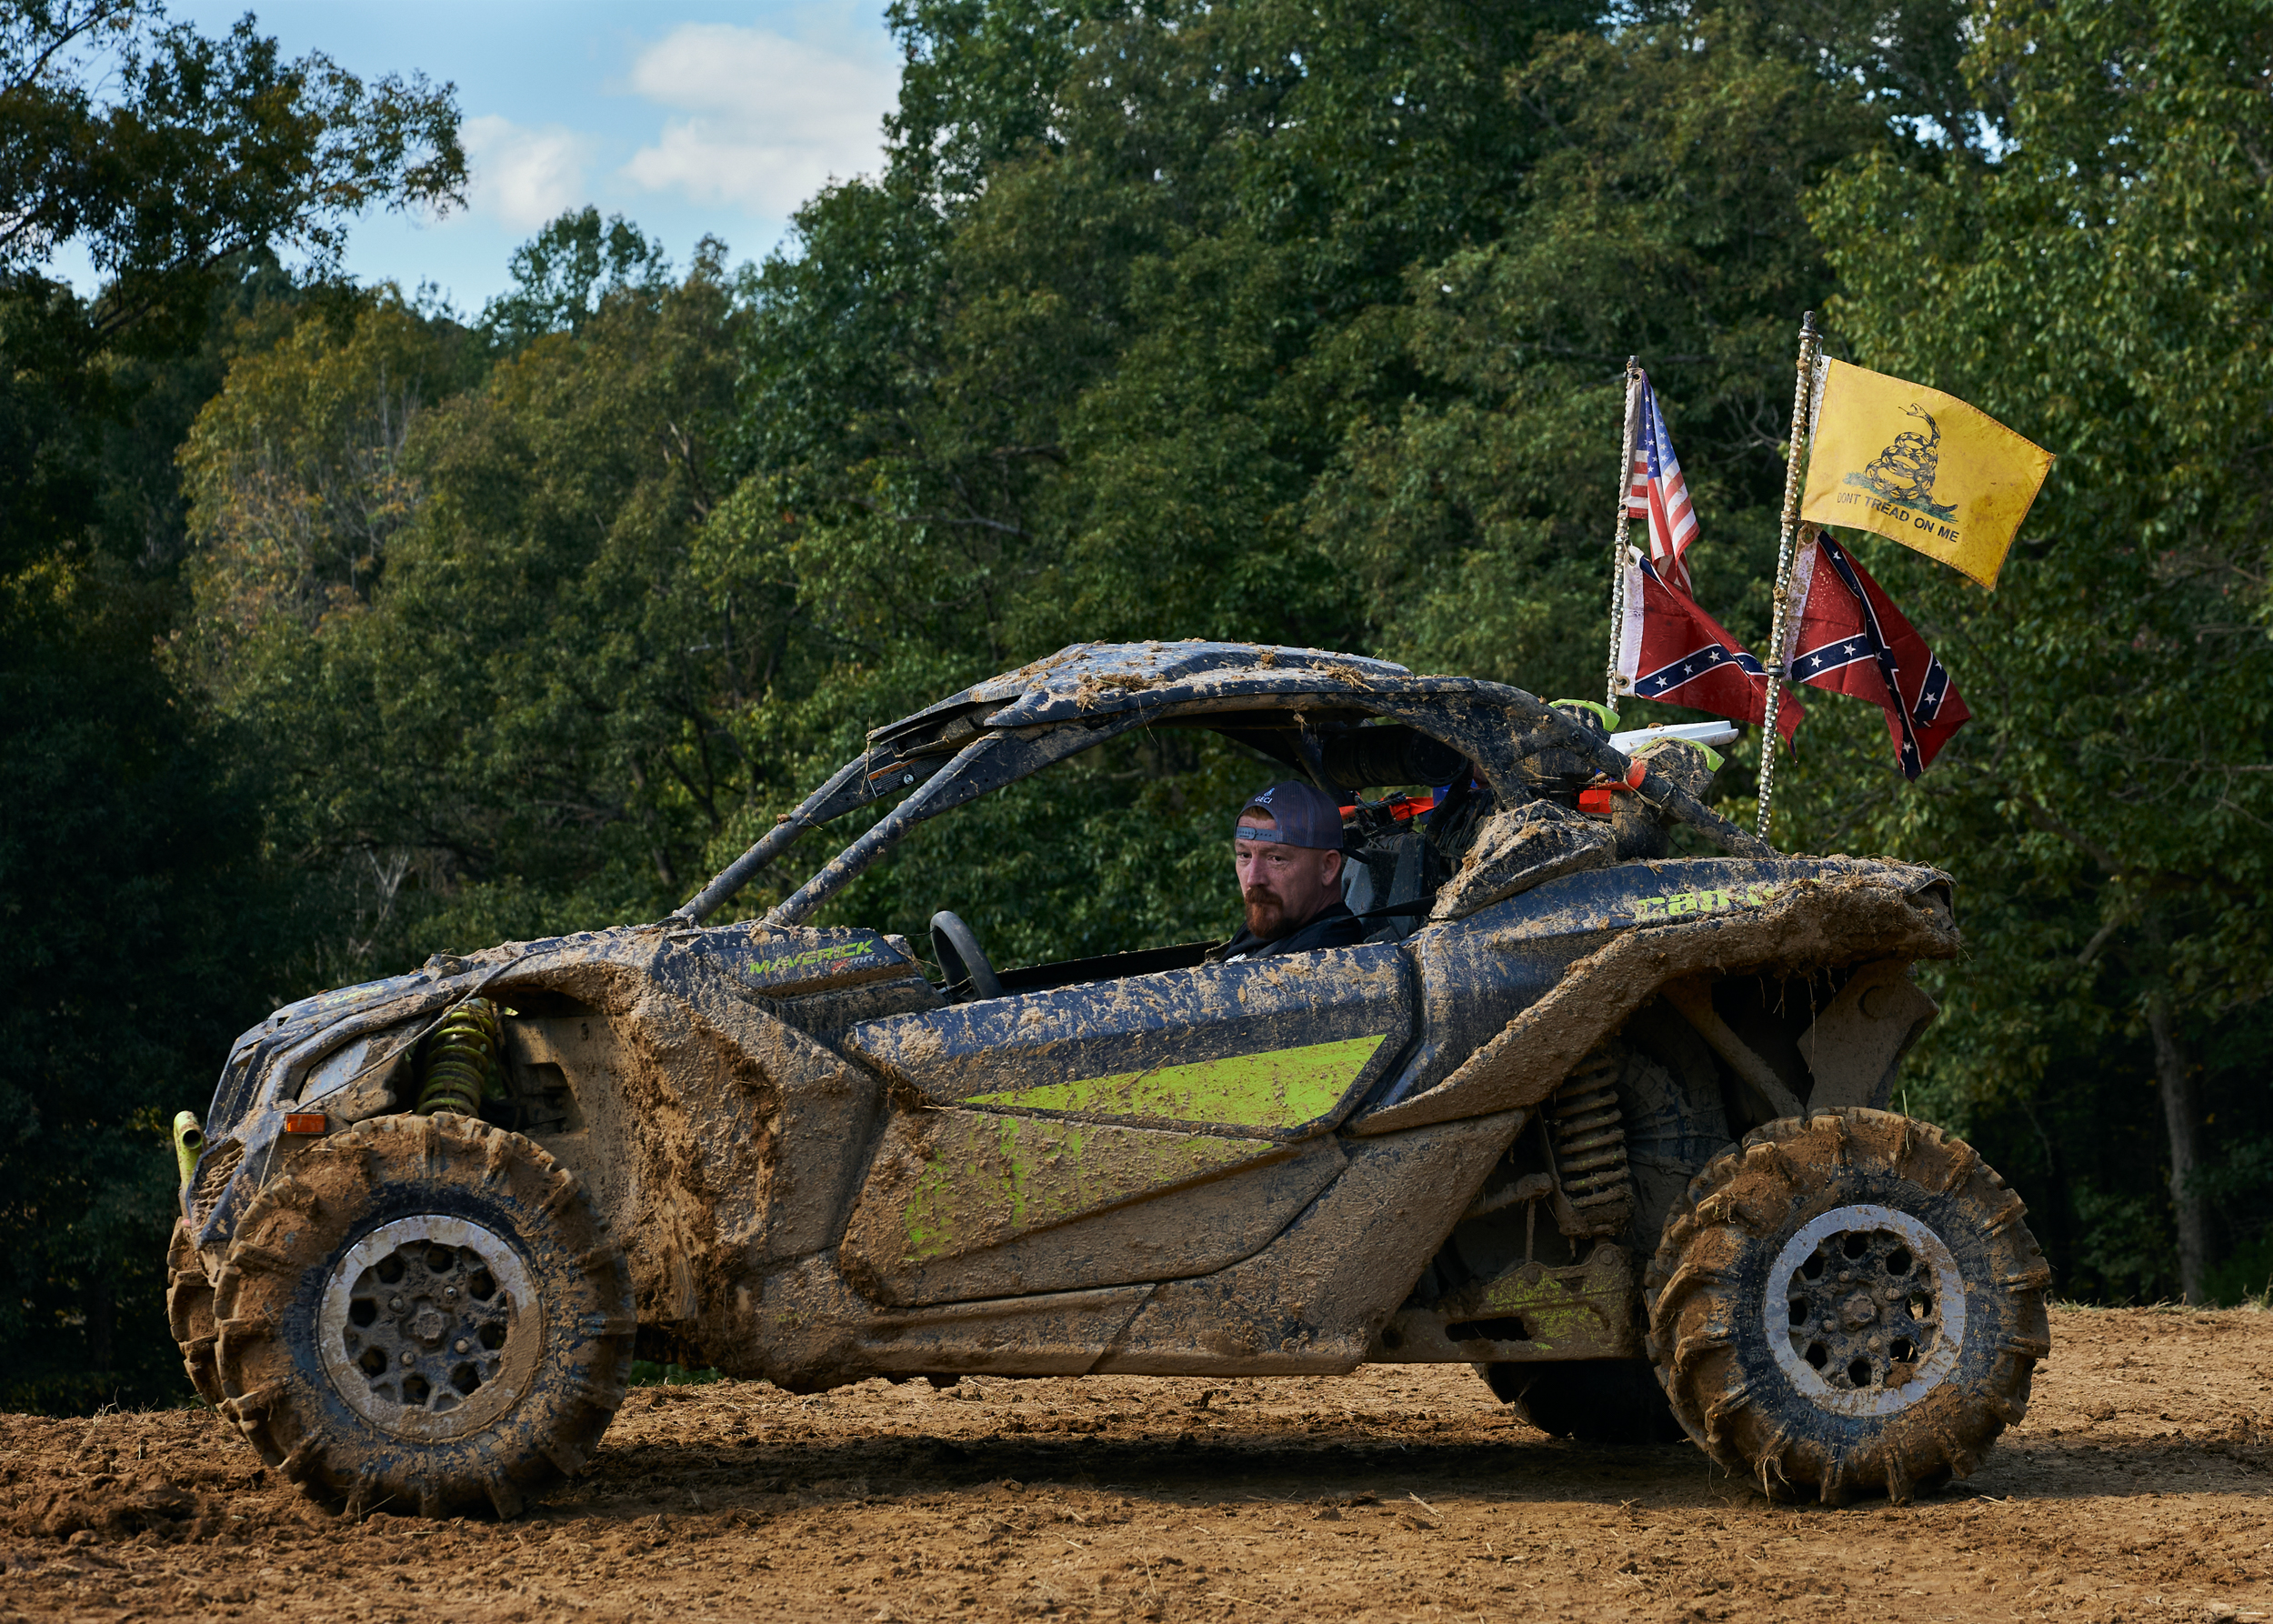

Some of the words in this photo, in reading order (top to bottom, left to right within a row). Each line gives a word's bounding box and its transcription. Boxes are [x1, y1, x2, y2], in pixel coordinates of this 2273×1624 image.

[1837, 492, 1862, 505] DONT
[1865, 496, 1910, 522] TREAD
[1914, 517, 1935, 533] ON
[1938, 526, 1960, 543] ME
[1636, 877, 1821, 921] can-
[749, 939, 875, 974] MAVERICK
